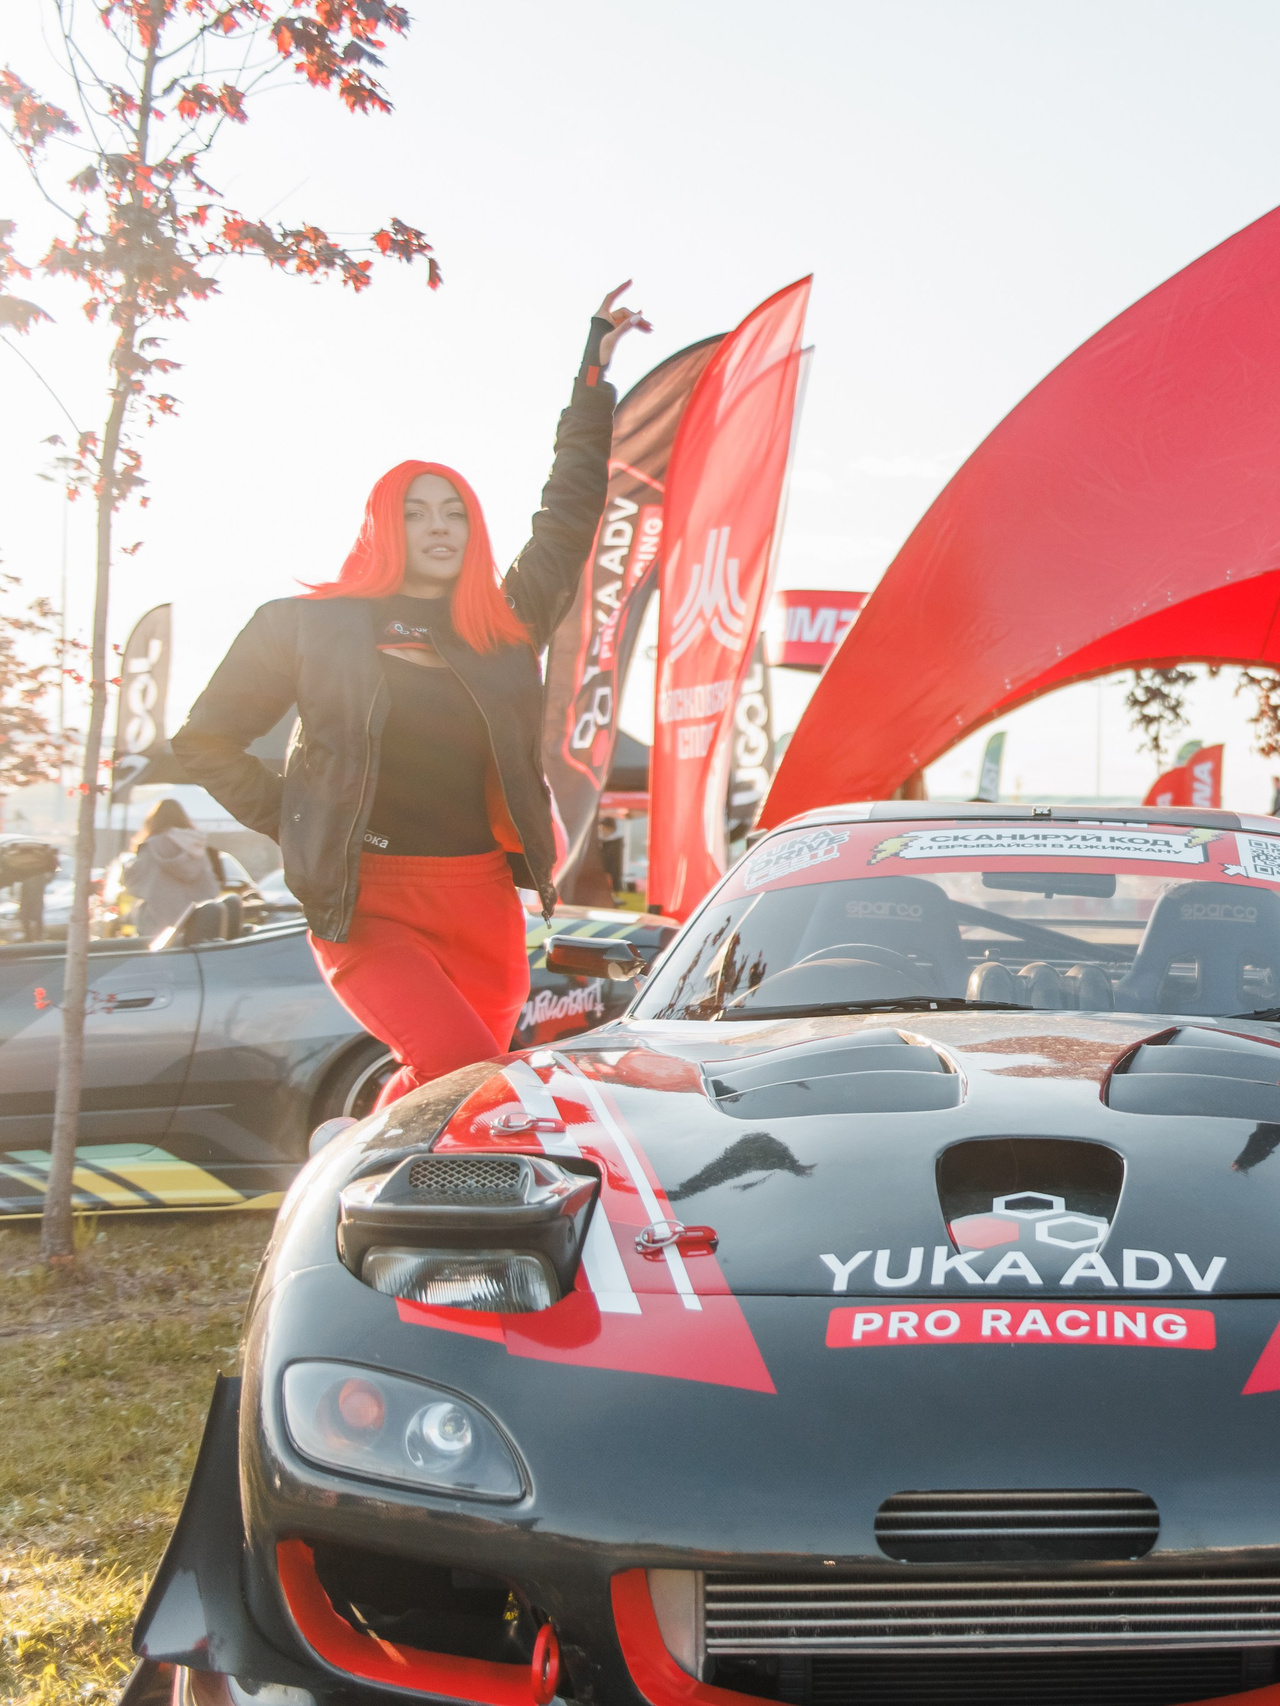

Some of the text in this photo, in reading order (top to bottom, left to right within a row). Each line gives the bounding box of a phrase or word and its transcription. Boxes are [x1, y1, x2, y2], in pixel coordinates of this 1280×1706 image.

[930, 833, 1172, 848] СКАНИРУЙ КОД
[1067, 844, 1182, 855] ДЖИМХАНУ
[846, 901, 922, 917] sparco
[1181, 904, 1257, 920] sparco
[820, 1245, 1227, 1292] YUKA ADV
[852, 1309, 1188, 1340] PRO RACING
